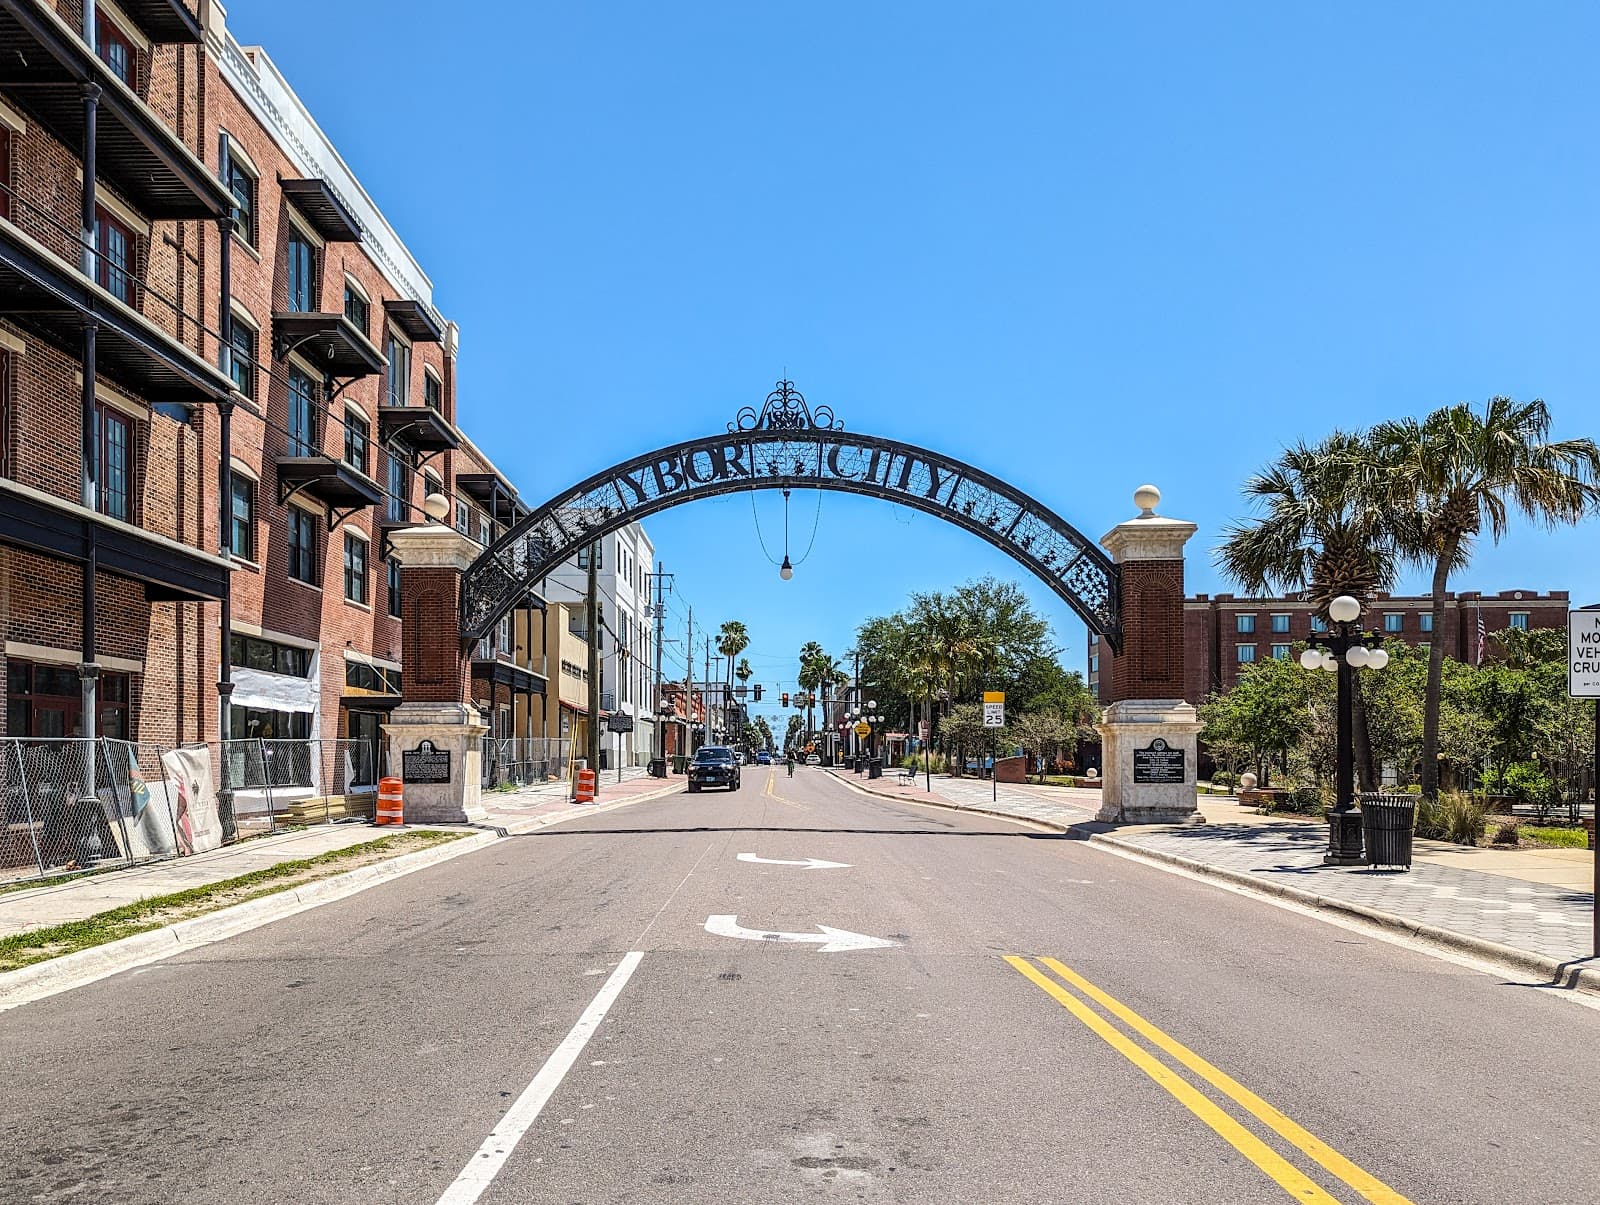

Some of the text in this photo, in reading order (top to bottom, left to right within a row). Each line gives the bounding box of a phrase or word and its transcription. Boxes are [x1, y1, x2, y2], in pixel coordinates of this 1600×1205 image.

[617, 444, 955, 503] YBOR CITY
[1573, 661, 1600, 673] CRU
[985, 715, 1002, 725] 25
